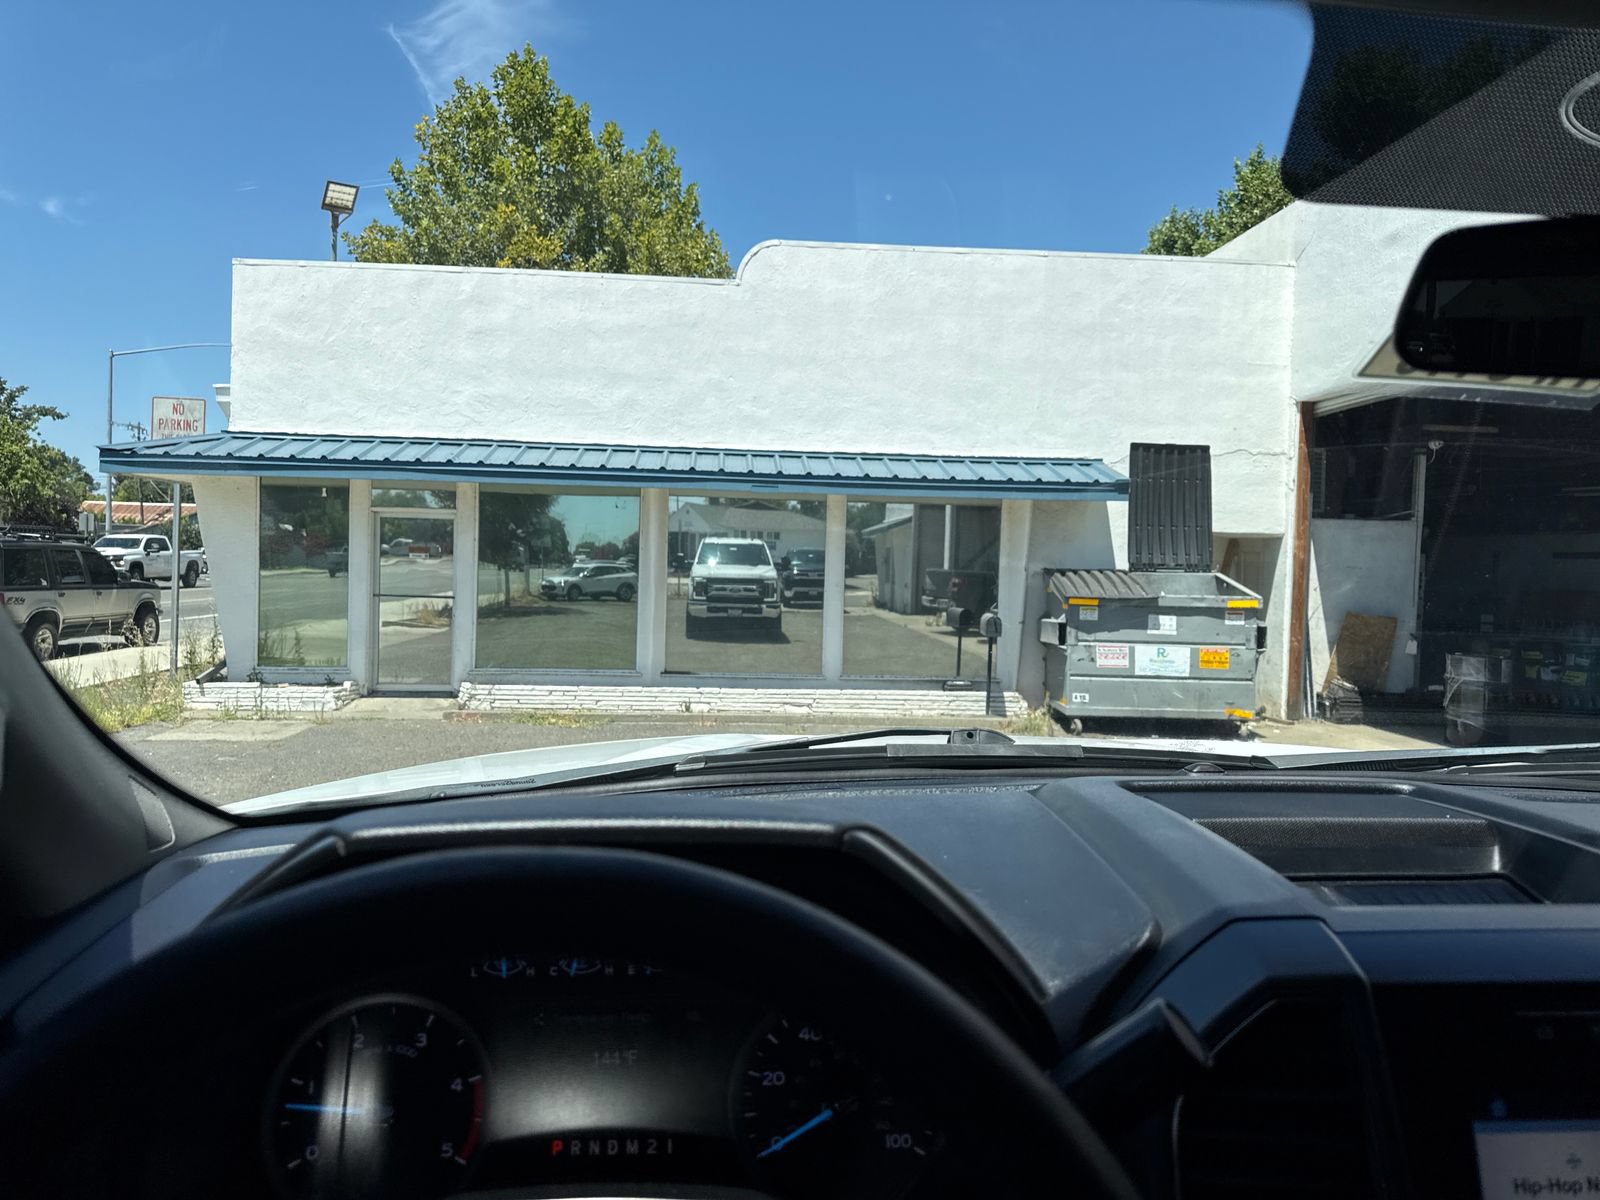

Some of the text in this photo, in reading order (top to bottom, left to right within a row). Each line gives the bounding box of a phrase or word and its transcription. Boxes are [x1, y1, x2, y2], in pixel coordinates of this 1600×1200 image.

[172, 403, 185, 415] NO
[158, 418, 198, 431] PARKING
[353, 1033, 365, 1048] 2
[416, 1032, 428, 1048] 3
[449, 1078, 462, 1092] 4
[761, 1071, 785, 1087] 20
[551, 1138, 564, 1157] P
[570, 1139, 581, 1156] R
[589, 1139, 600, 1156] N
[607, 1139, 619, 1155] D
[626, 1139, 639, 1155] M
[647, 1138, 657, 1155] 2
[884, 1133, 912, 1149] 100
[305, 1145, 319, 1160] 0
[440, 1142, 453, 1158] 5
[1513, 1177, 1583, 1196] Hip-Hop
